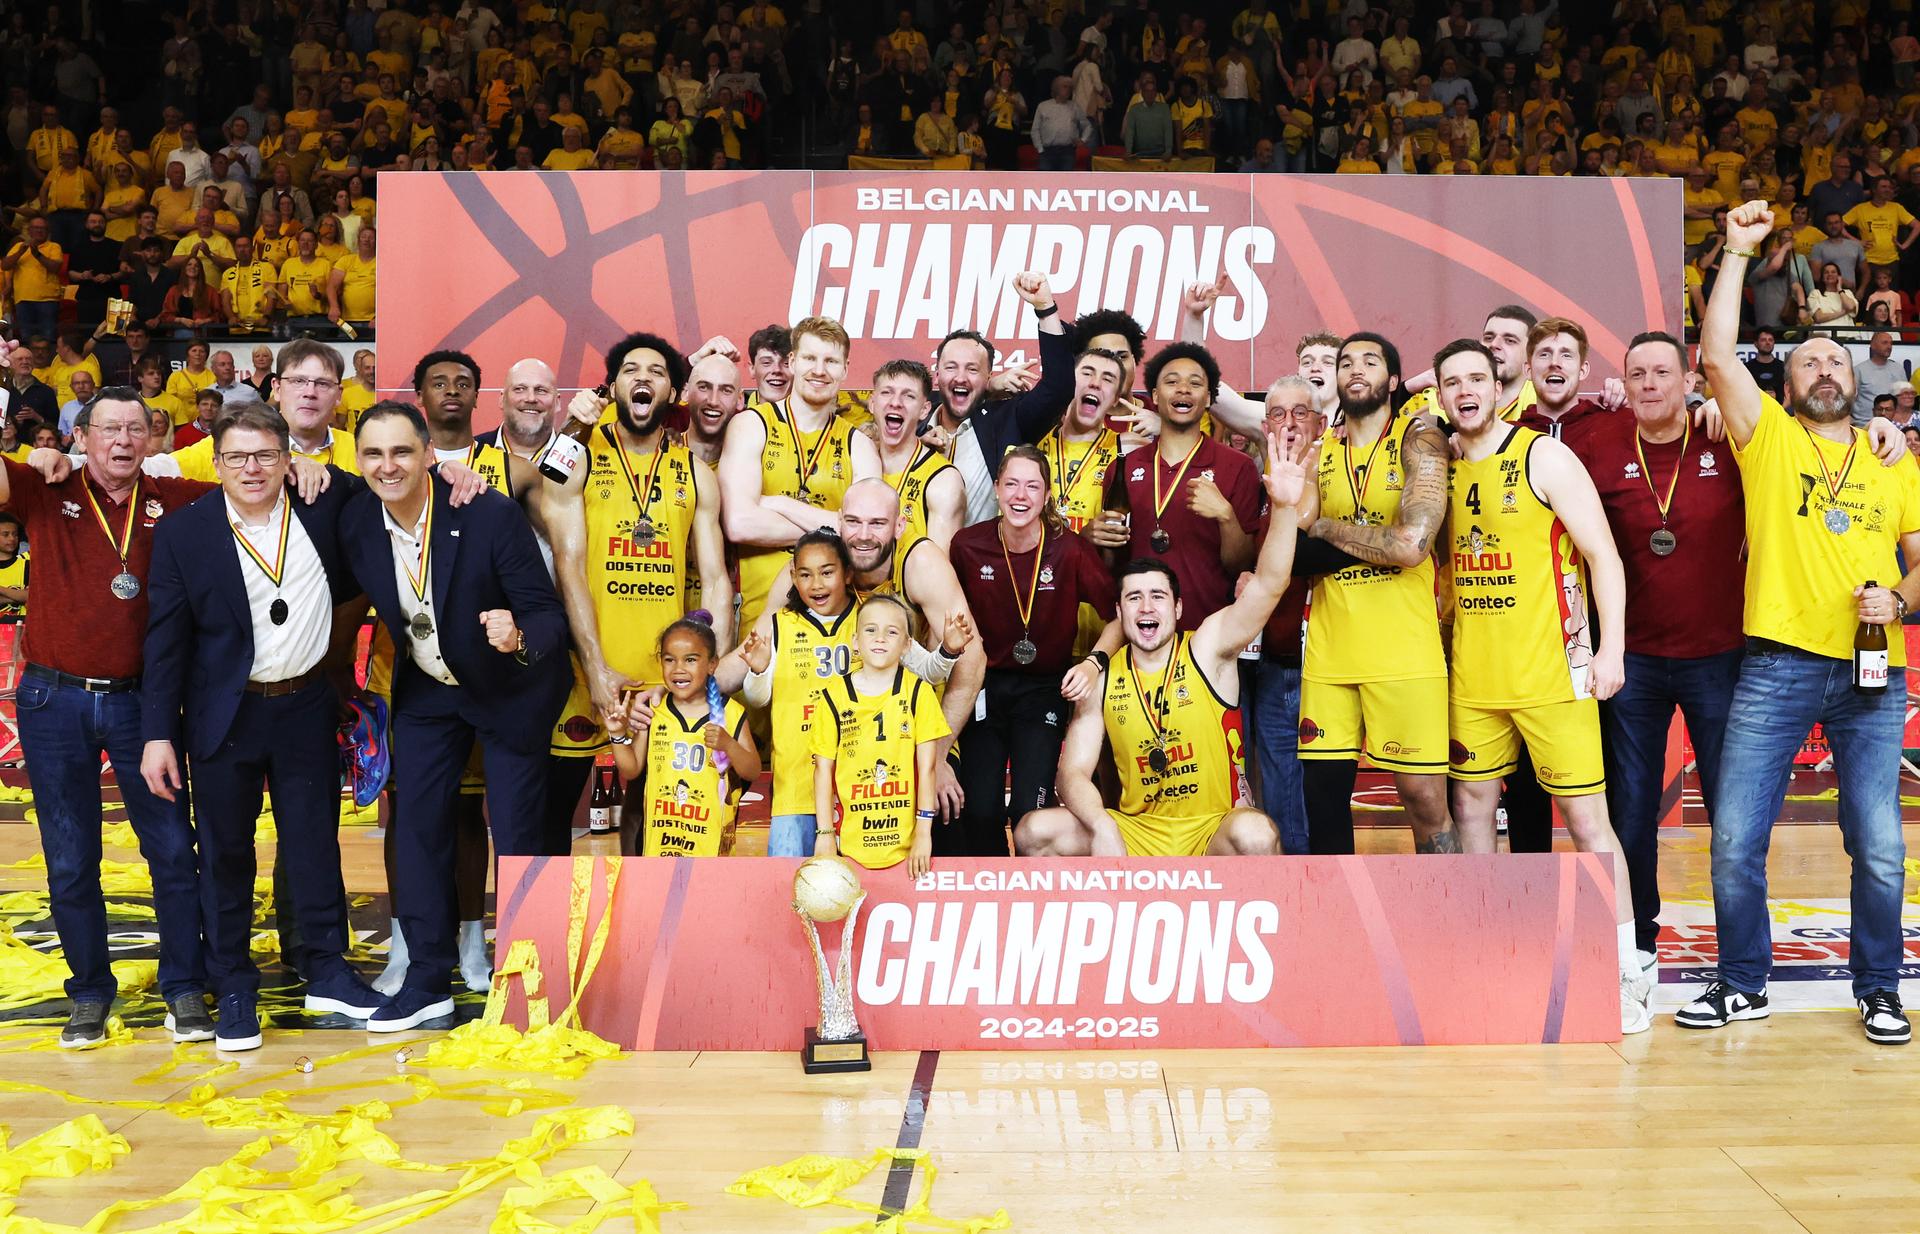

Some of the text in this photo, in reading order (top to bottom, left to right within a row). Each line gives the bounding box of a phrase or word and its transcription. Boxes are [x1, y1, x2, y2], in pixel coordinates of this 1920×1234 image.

[856, 188, 1210, 213] BELGIAN NATIONAL
[788, 223, 1276, 341] CHAMPIONS
[595, 479, 615, 487] RAES
[1465, 483, 1481, 516] 4
[1453, 552, 1512, 572] FILOU
[607, 580, 675, 596] Coretec
[1455, 575, 1517, 587] OOSTENDE
[1458, 595, 1516, 609] Coretec
[814, 644, 850, 678] 30
[1112, 704, 1129, 712] RAES
[872, 711, 887, 742] 1
[842, 740, 859, 748] RAES
[672, 741, 706, 772] 30
[1135, 742, 1194, 774] FOU
[850, 780, 909, 801] FILOU
[653, 799, 710, 822] FILOU
[850, 800, 911, 812] OOSTENDE
[862, 815, 898, 830] bwin
[660, 832, 696, 851] bwin
[863, 833, 900, 842] CASINO
[863, 840, 900, 848] OOSTENDE
[915, 869, 1223, 892] BELGIAN NATIONAL
[856, 900, 1280, 1006] CHAMPIONS
[979, 1016, 1160, 1039] 2024-2025
